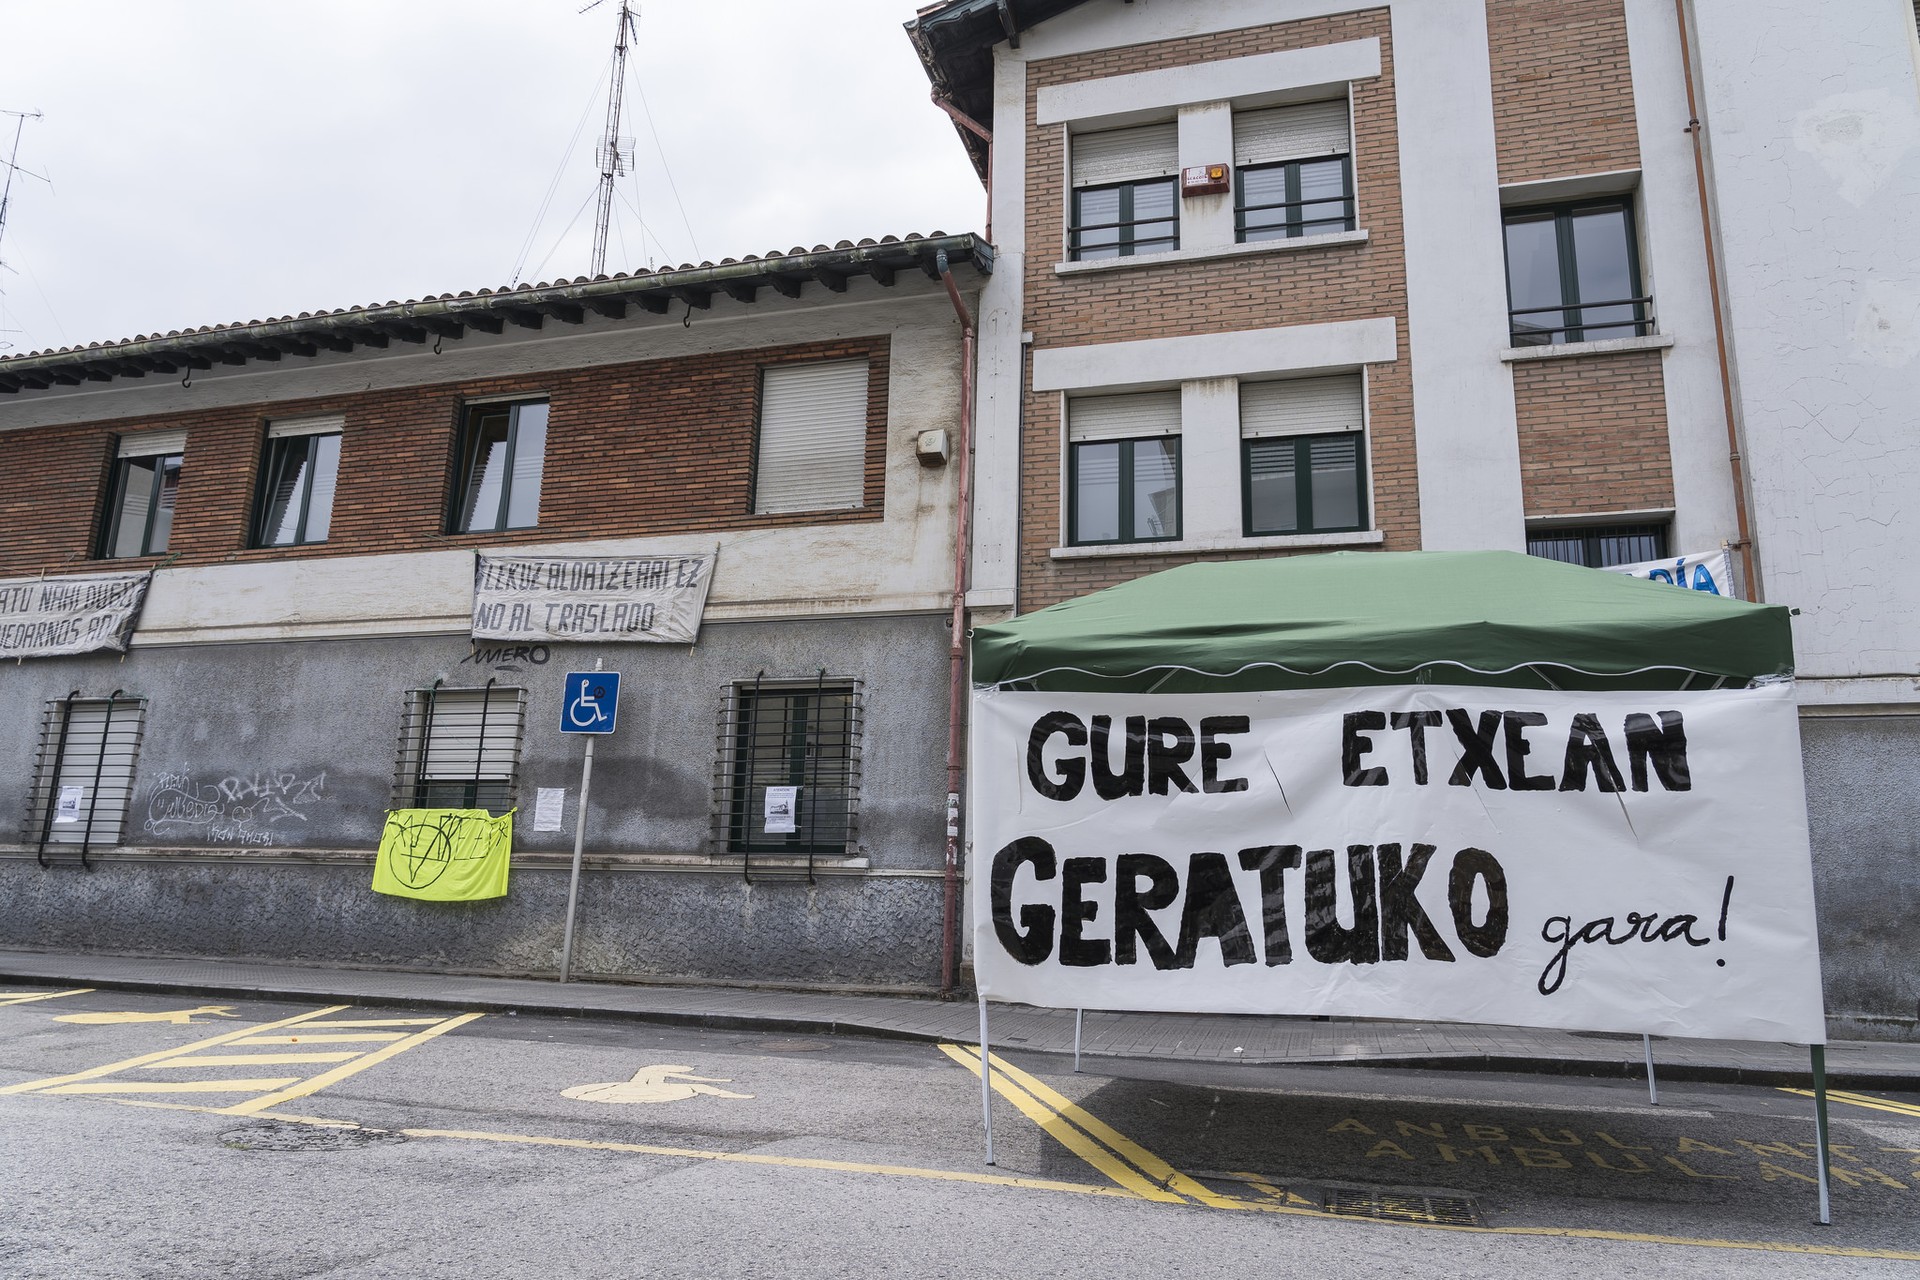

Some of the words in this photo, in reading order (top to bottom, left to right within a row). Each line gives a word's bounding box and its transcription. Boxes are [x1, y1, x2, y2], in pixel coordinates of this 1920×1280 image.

[676, 559, 704, 589] EZ
[475, 602, 506, 631] NO
[509, 603, 534, 632] AL
[545, 602, 656, 634] TRASLADO
[1027, 711, 1250, 802] GURE
[1342, 708, 1692, 796] ETXEAN
[991, 835, 1510, 971] GERATUKO
[1538, 876, 1736, 996] gara!
[1366, 1139, 1920, 1190] AMBULAN
